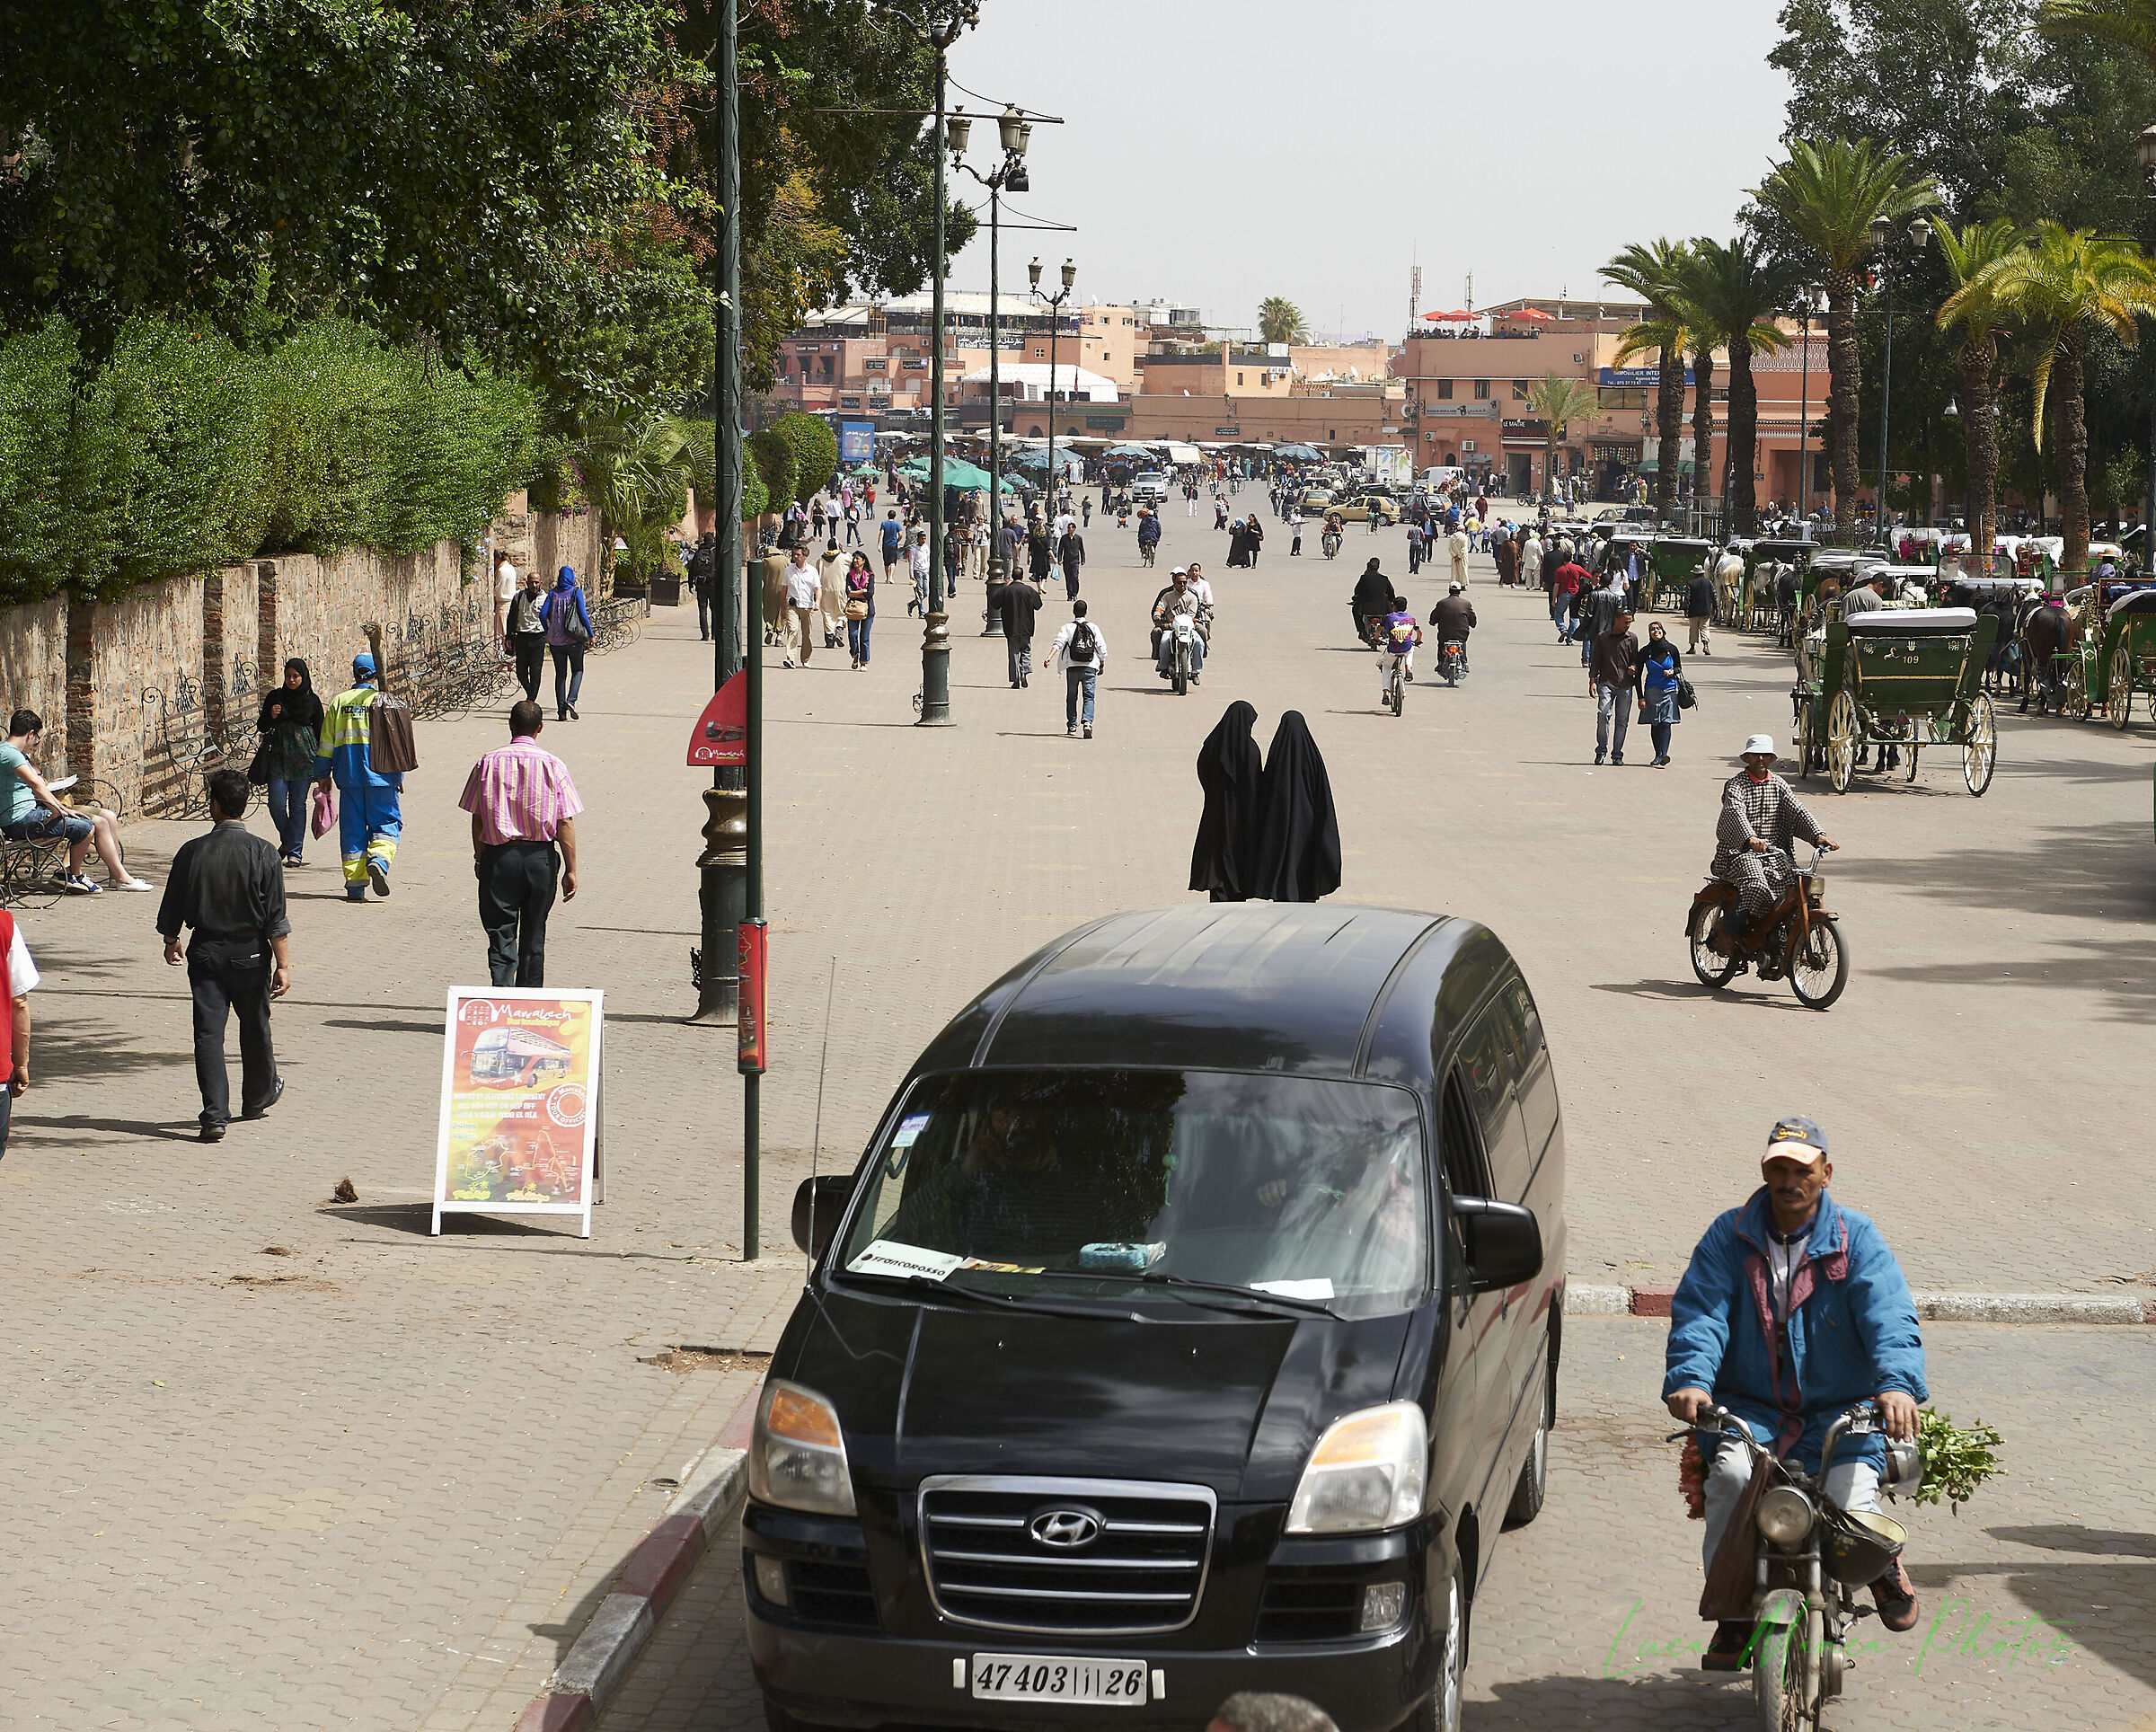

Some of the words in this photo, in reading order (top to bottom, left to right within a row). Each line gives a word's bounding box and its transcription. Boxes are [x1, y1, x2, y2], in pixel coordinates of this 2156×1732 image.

[1904, 655, 1919, 664] 109
[524, 1102, 536, 1110] OFF
[976, 1663, 1068, 1693] 47403
[1105, 1668, 1143, 1696] 26
